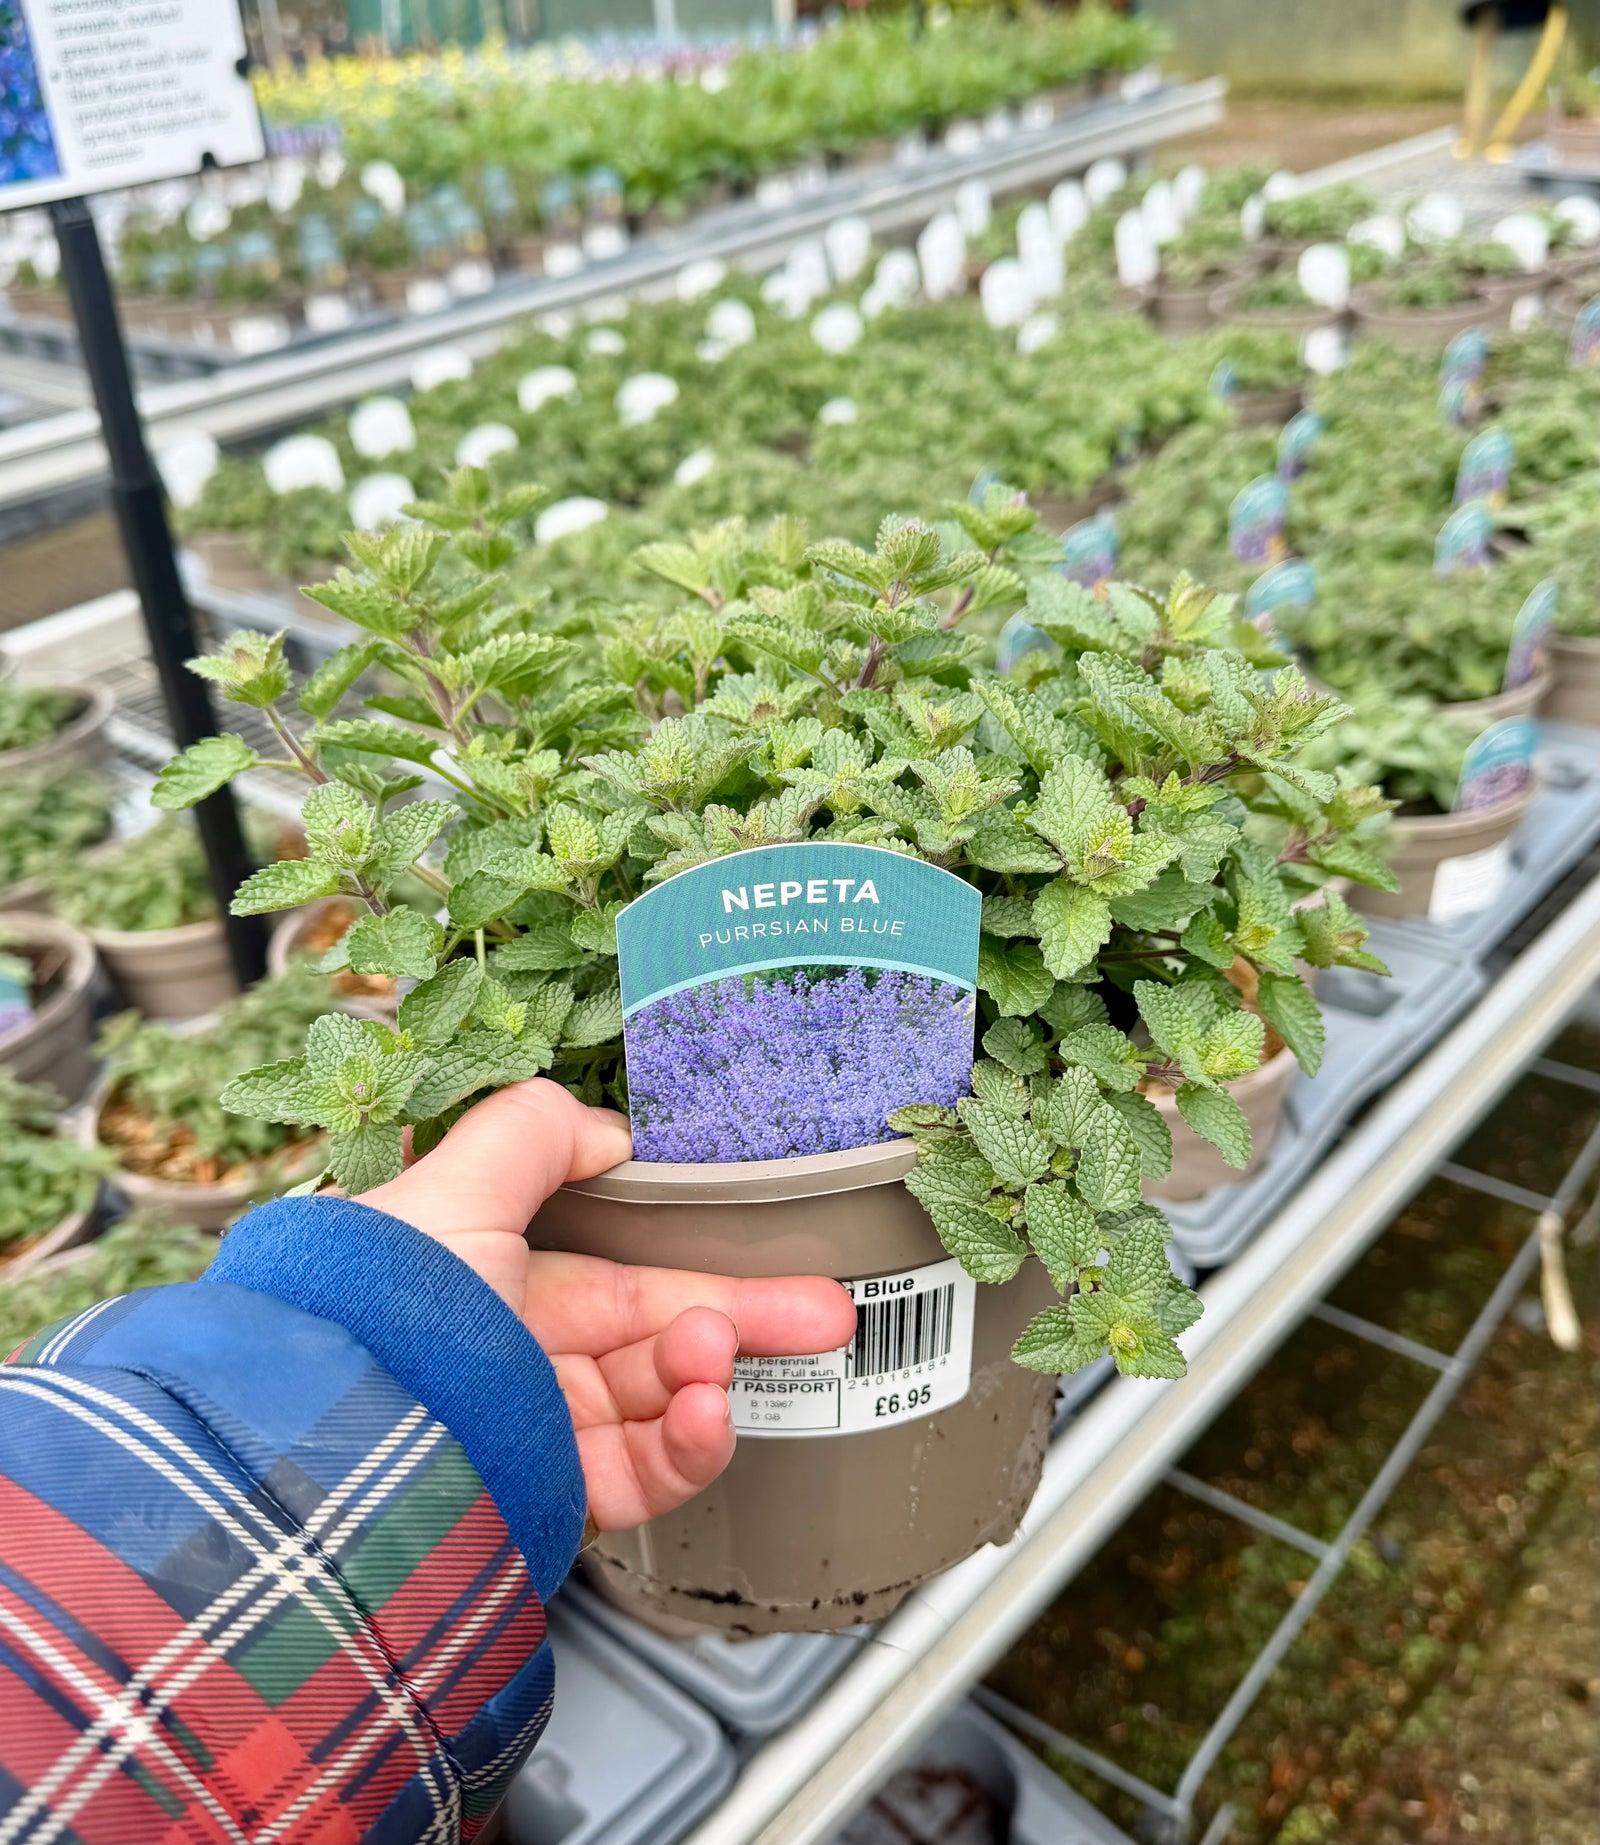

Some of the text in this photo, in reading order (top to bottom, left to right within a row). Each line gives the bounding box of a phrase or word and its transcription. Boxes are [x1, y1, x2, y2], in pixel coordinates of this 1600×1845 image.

[721, 879, 880, 914] NEPETA
[699, 917, 905, 949] PURRSIAN BLUE
[864, 1278, 916, 1298] Blue
[758, 1356, 819, 1367] perennial
[782, 1368, 806, 1377] Full
[810, 1368, 838, 1378] sun.
[744, 1381, 836, 1393] PASSPORT
[874, 1383, 932, 1417] £6.95
